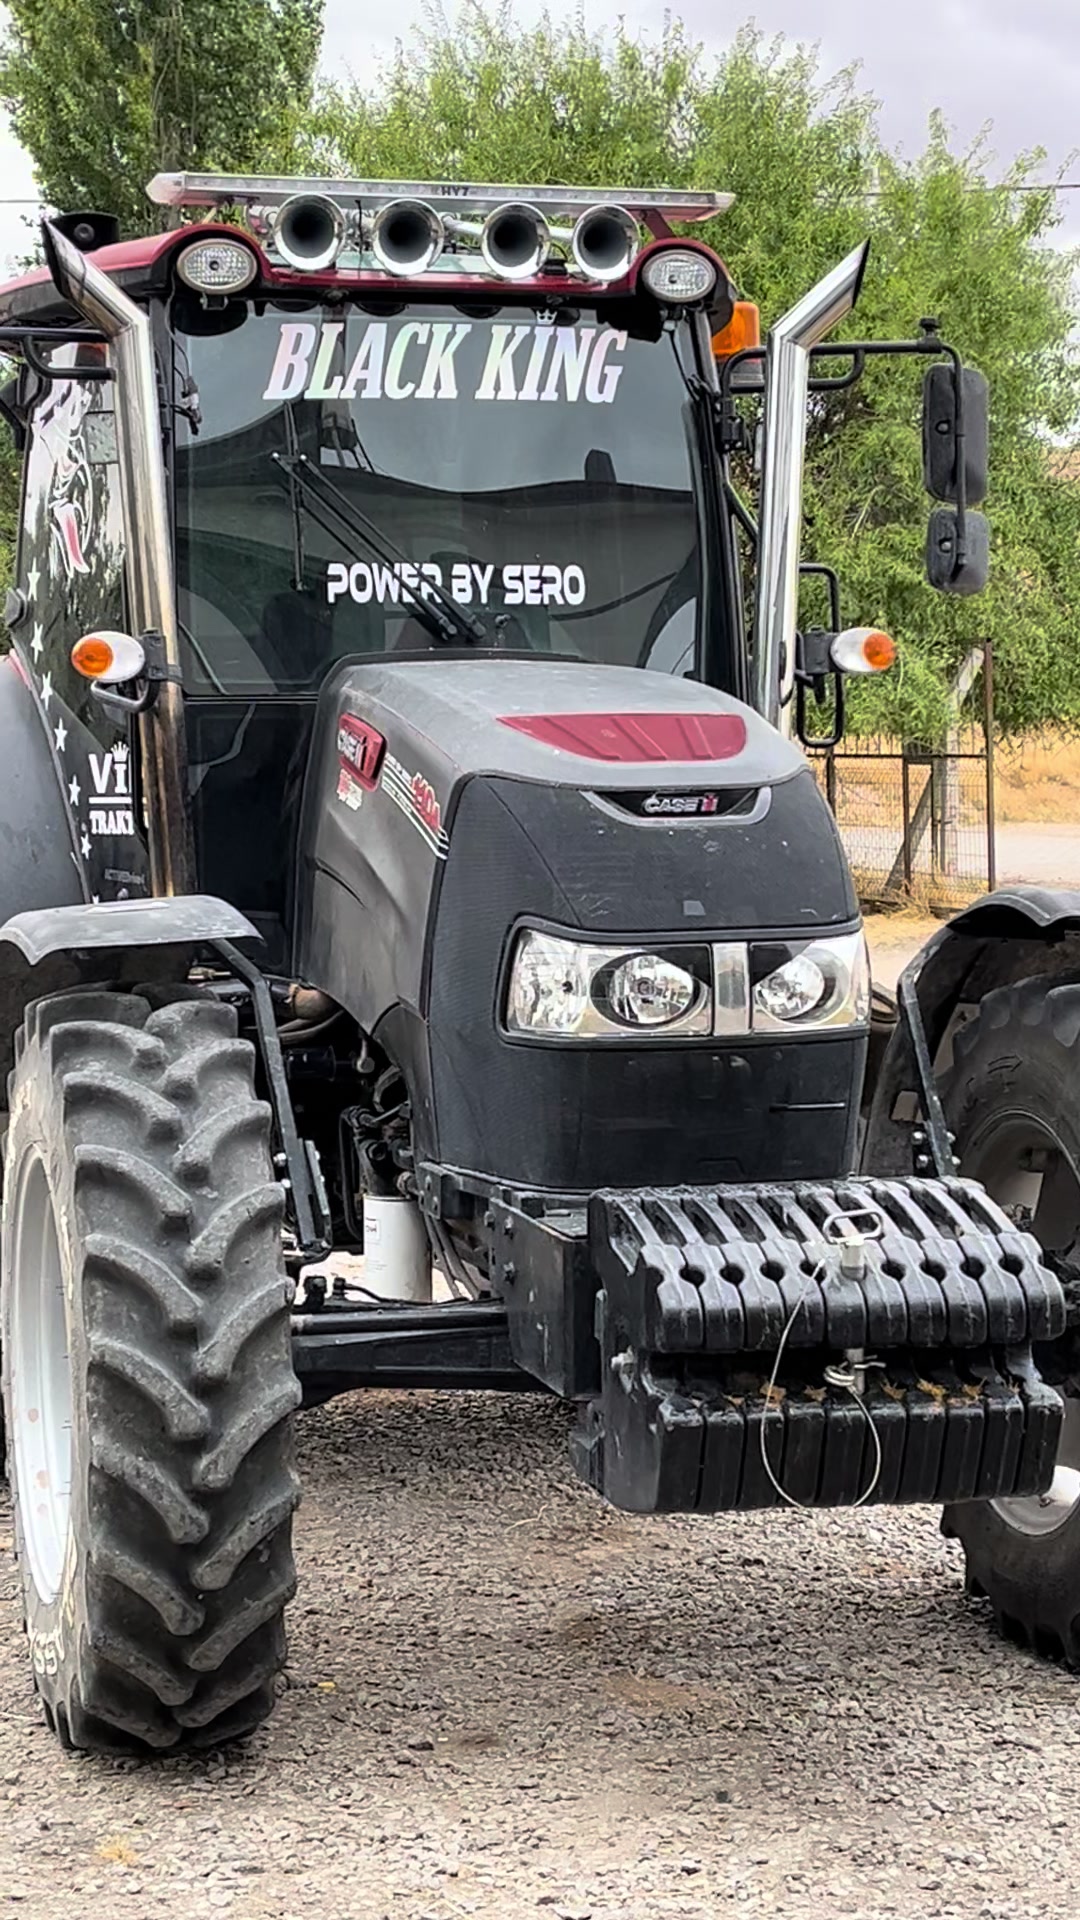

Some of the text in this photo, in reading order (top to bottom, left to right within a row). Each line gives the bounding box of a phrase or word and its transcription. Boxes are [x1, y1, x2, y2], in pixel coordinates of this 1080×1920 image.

[263, 322, 628, 404] BLACK KING
[327, 562, 586, 606] POWER BY SERO
[88, 753, 132, 794] VI
[643, 794, 698, 813] CASE
